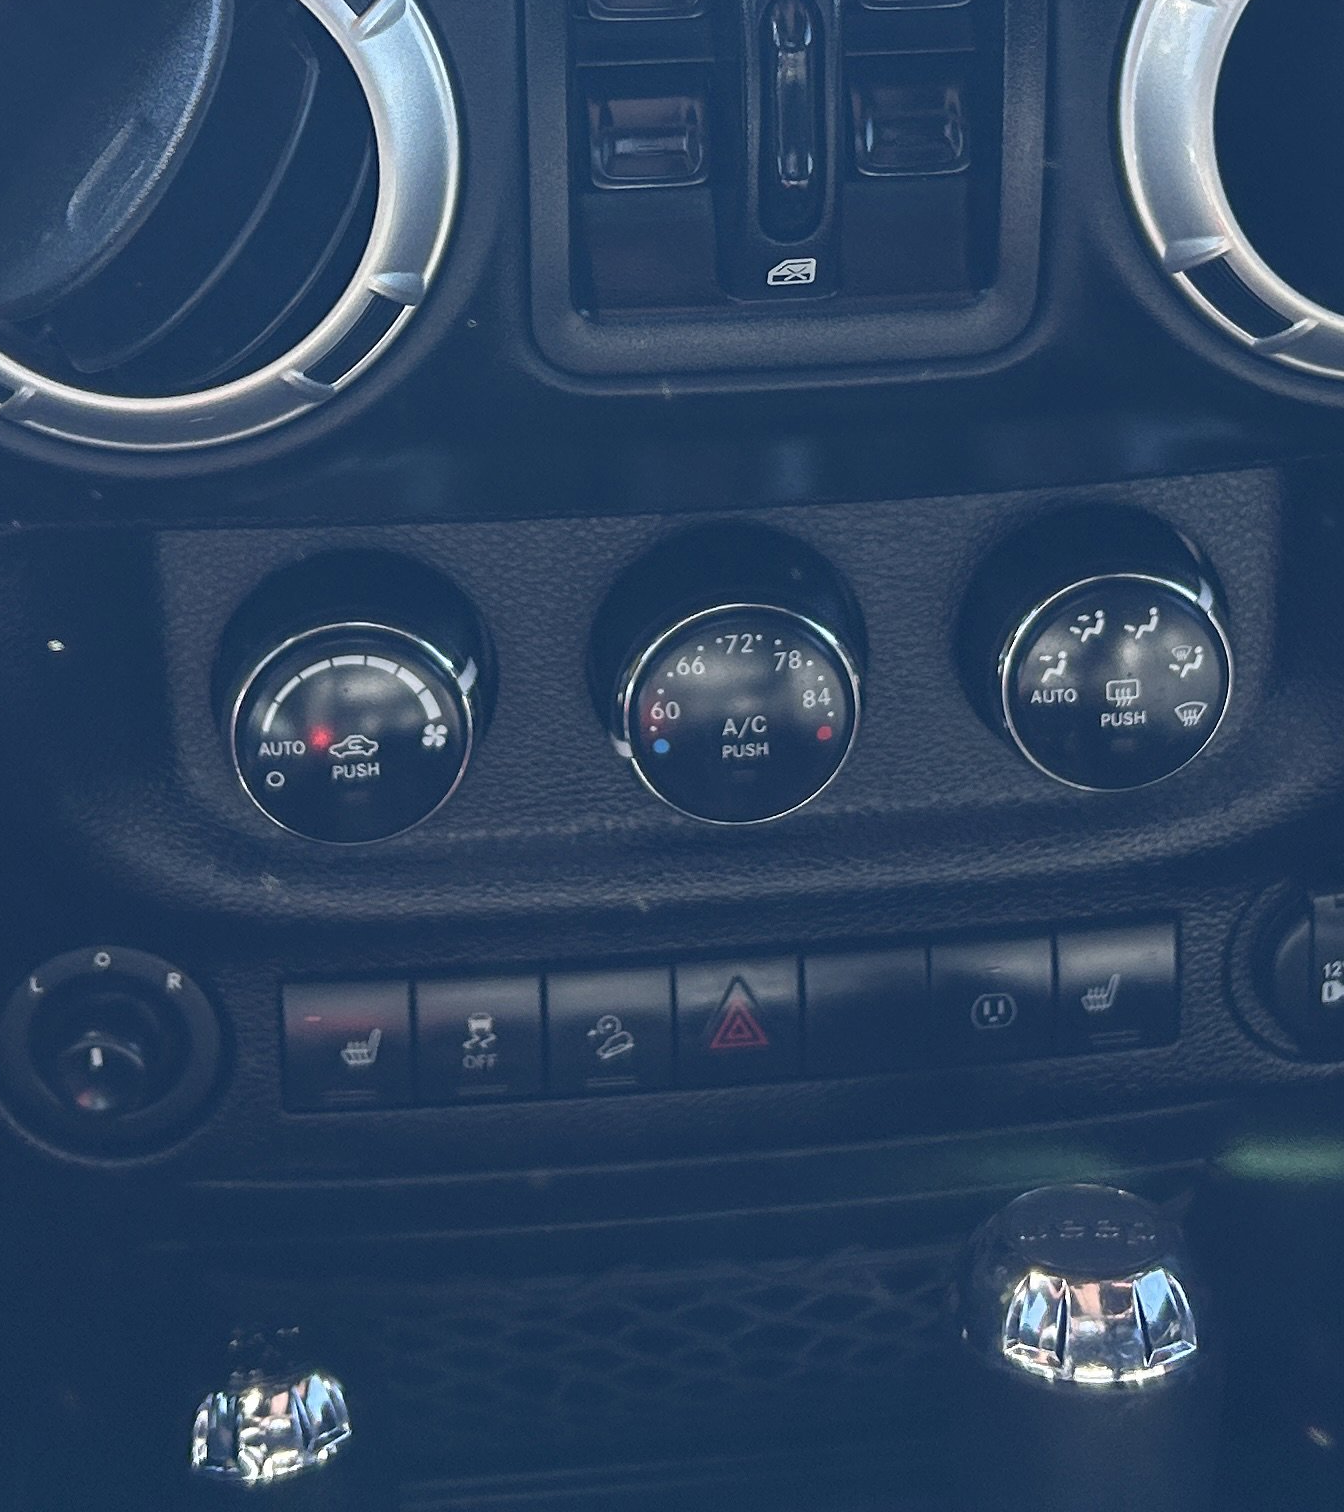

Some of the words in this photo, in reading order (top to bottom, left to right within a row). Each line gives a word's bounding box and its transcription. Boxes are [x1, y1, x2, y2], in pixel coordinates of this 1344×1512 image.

[676, 655, 706, 676] 66
[774, 650, 802, 672] 78
[802, 687, 832, 709] 84
[1030, 687, 1078, 704] AUTO
[650, 700, 681, 720] 60
[722, 715, 767, 738] A/C
[1100, 711, 1146, 728] PUSH
[259, 740, 306, 757] AUTO
[722, 742, 770, 759] PUSH
[332, 762, 380, 780] PUSH
[29, 976, 44, 993] L
[167, 972, 183, 990] R
[462, 1053, 498, 1070] OFF
